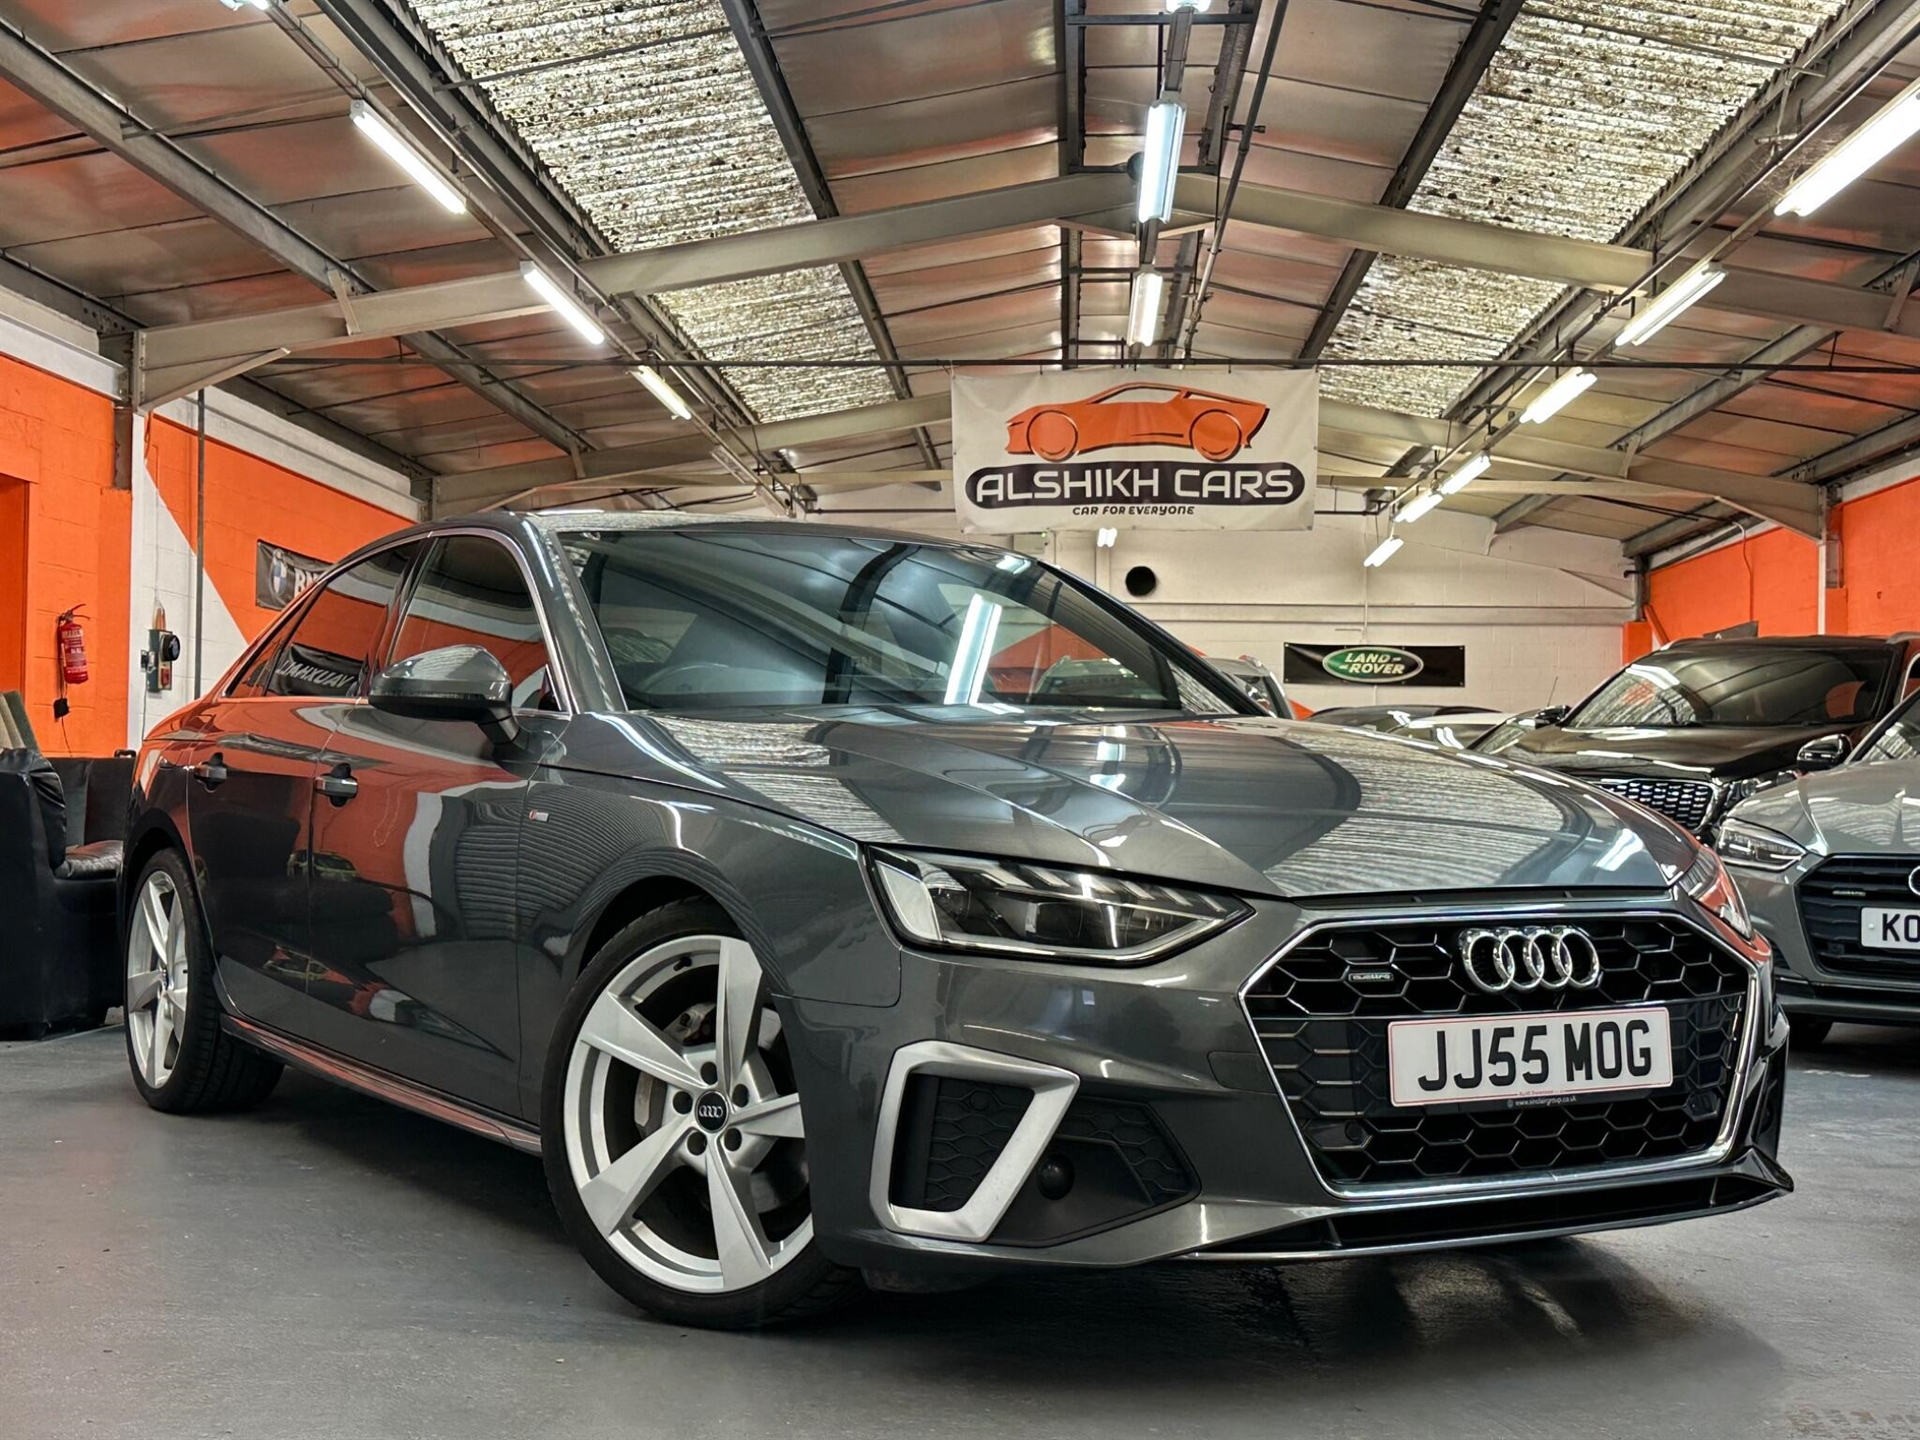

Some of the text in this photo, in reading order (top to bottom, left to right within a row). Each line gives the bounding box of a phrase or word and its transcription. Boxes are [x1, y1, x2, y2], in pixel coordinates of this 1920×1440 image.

[976, 467, 1294, 502] ALSHIKH CARS
[1072, 505, 1195, 516] CAR FOR EVERYONE
[1344, 653, 1389, 664] LAND
[1349, 663, 1405, 675] ROVER
[1417, 1019, 1652, 1091] JJ55 MOG
